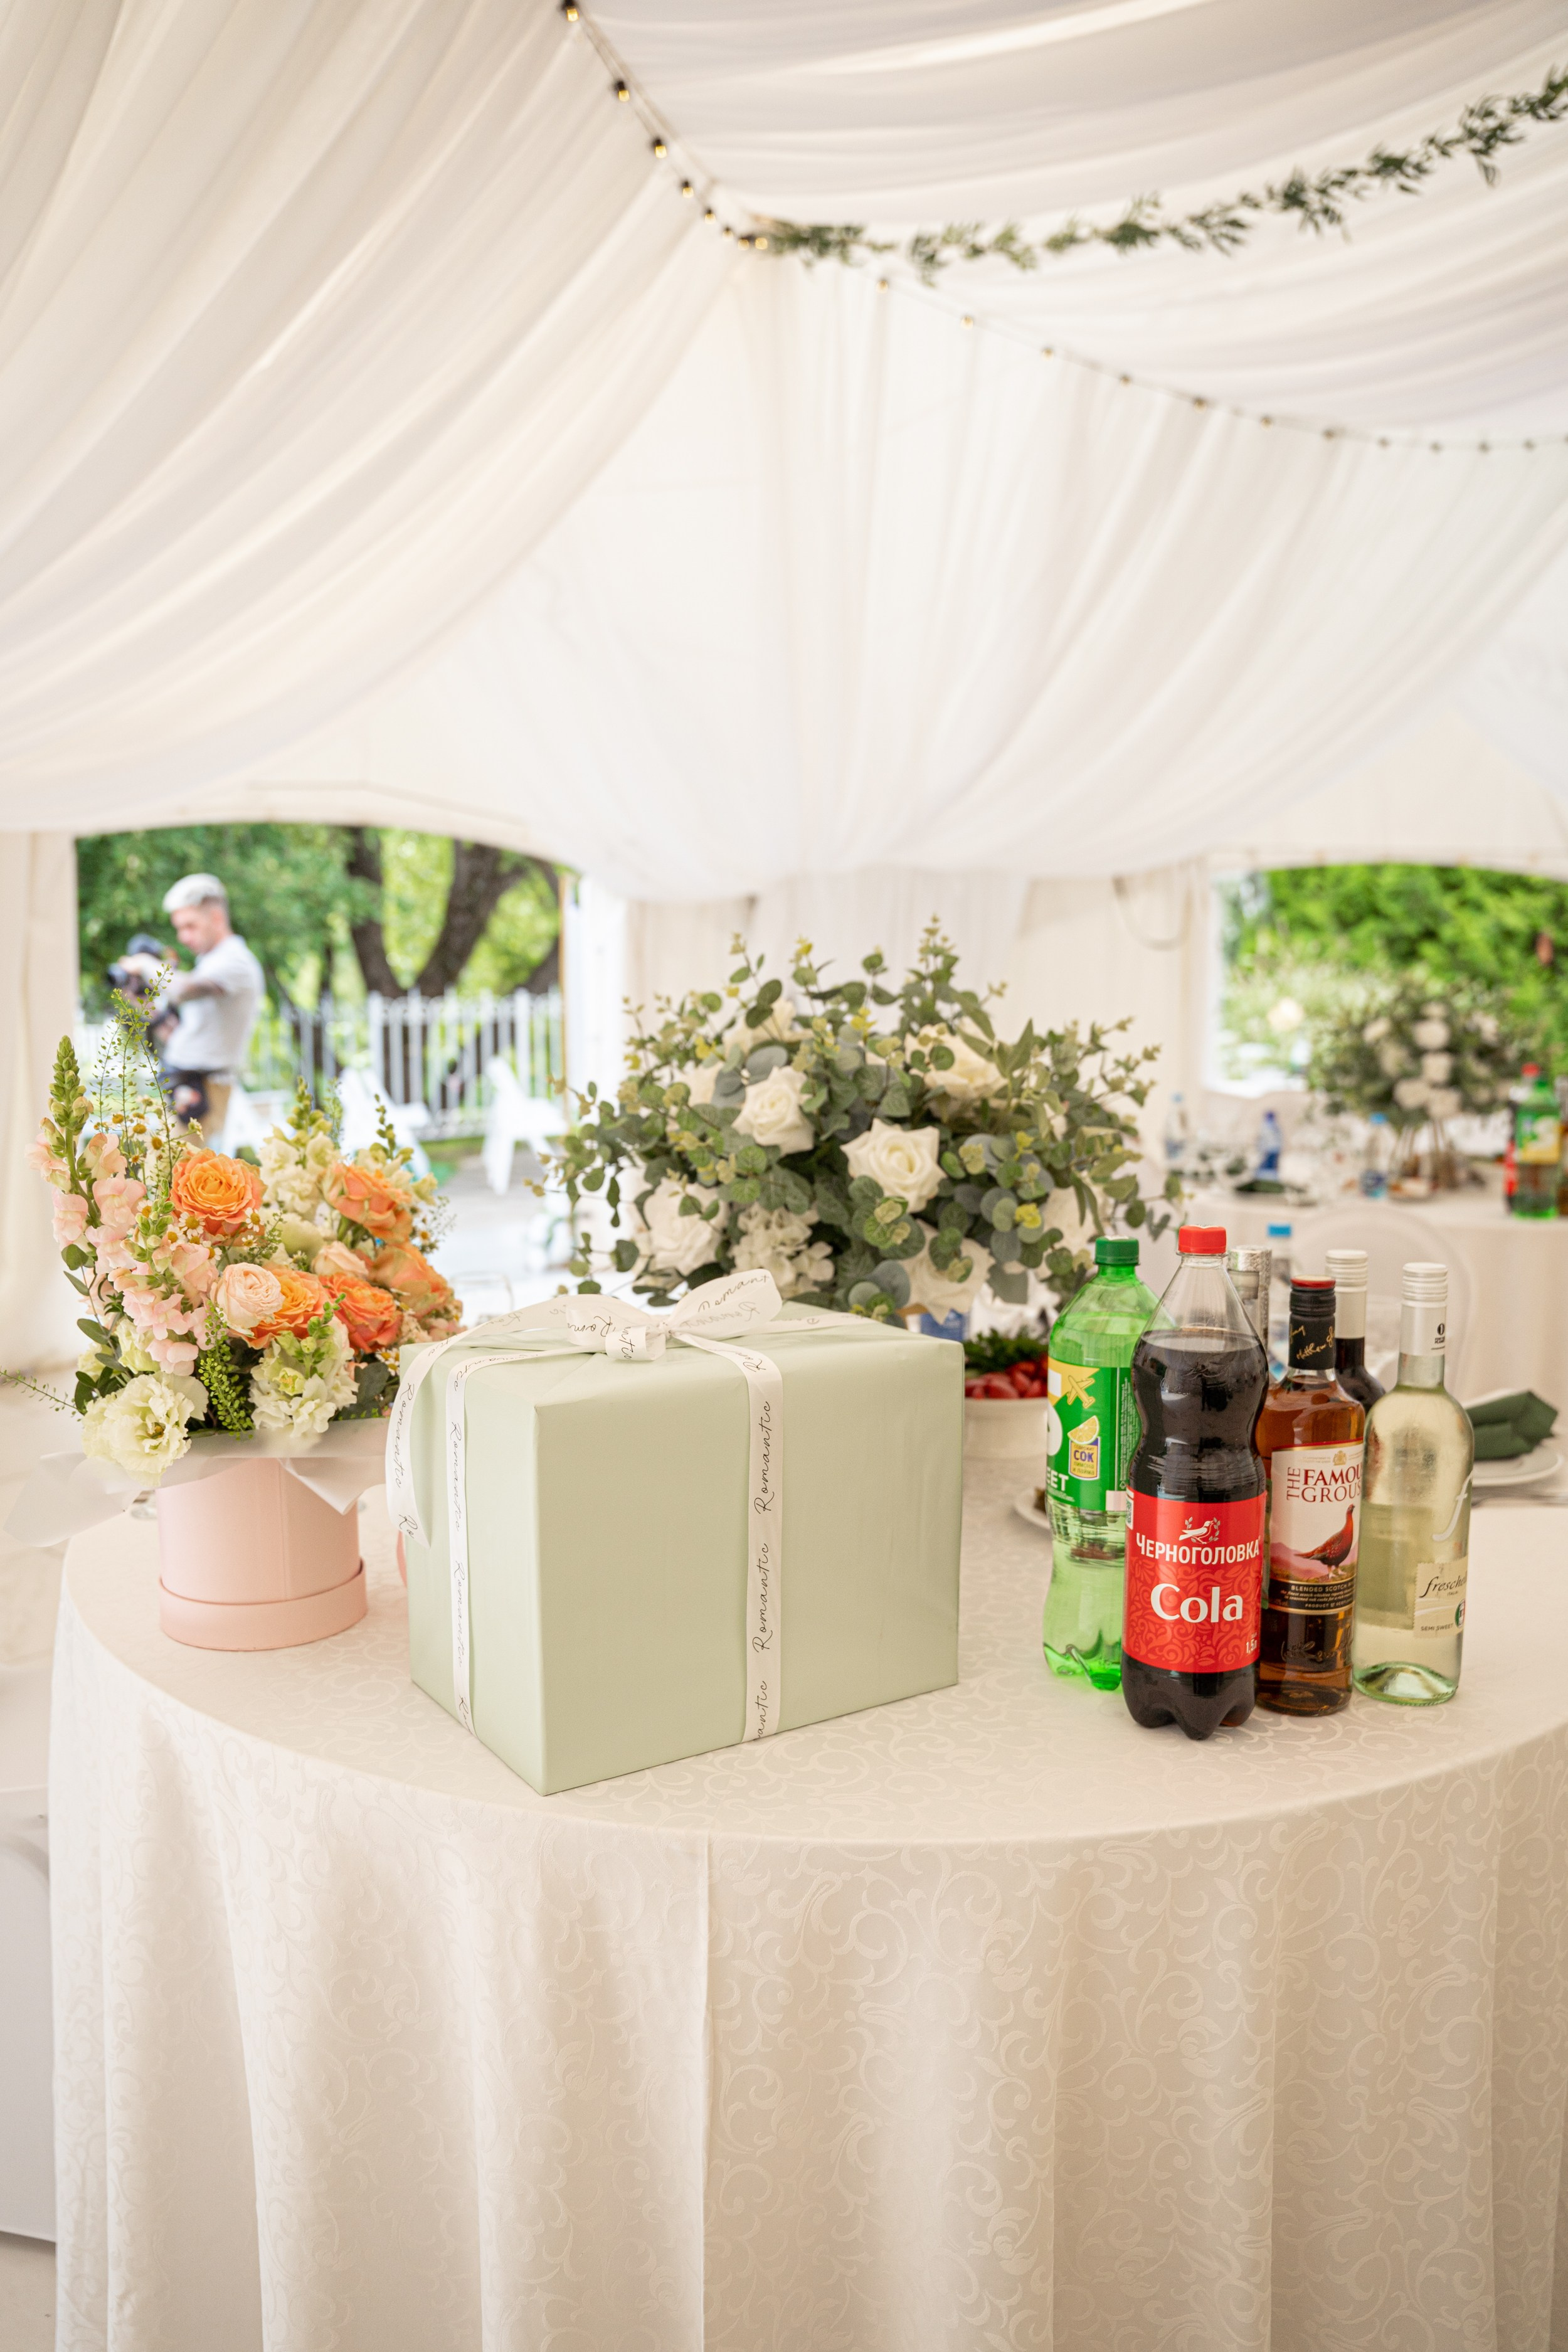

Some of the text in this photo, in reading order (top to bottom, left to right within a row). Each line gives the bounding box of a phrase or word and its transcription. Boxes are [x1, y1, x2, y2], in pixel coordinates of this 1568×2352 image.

[393, 1382, 415, 1488] Romantic
[754, 1401, 775, 1515] Romantic
[1073, 1449, 1094, 1463] СОК
[450, 1421, 462, 1532] Romantic
[1286, 1466, 1301, 1501] THE
[1136, 1532, 1260, 1565] ЧЕРНОГОЛОВКА
[752, 1543, 773, 1653] Romantic
[1150, 1583, 1243, 1623] Cola
[1325, 1583, 1347, 1592] SCOTCH
[1436, 1623, 1454, 1631] SWEET
